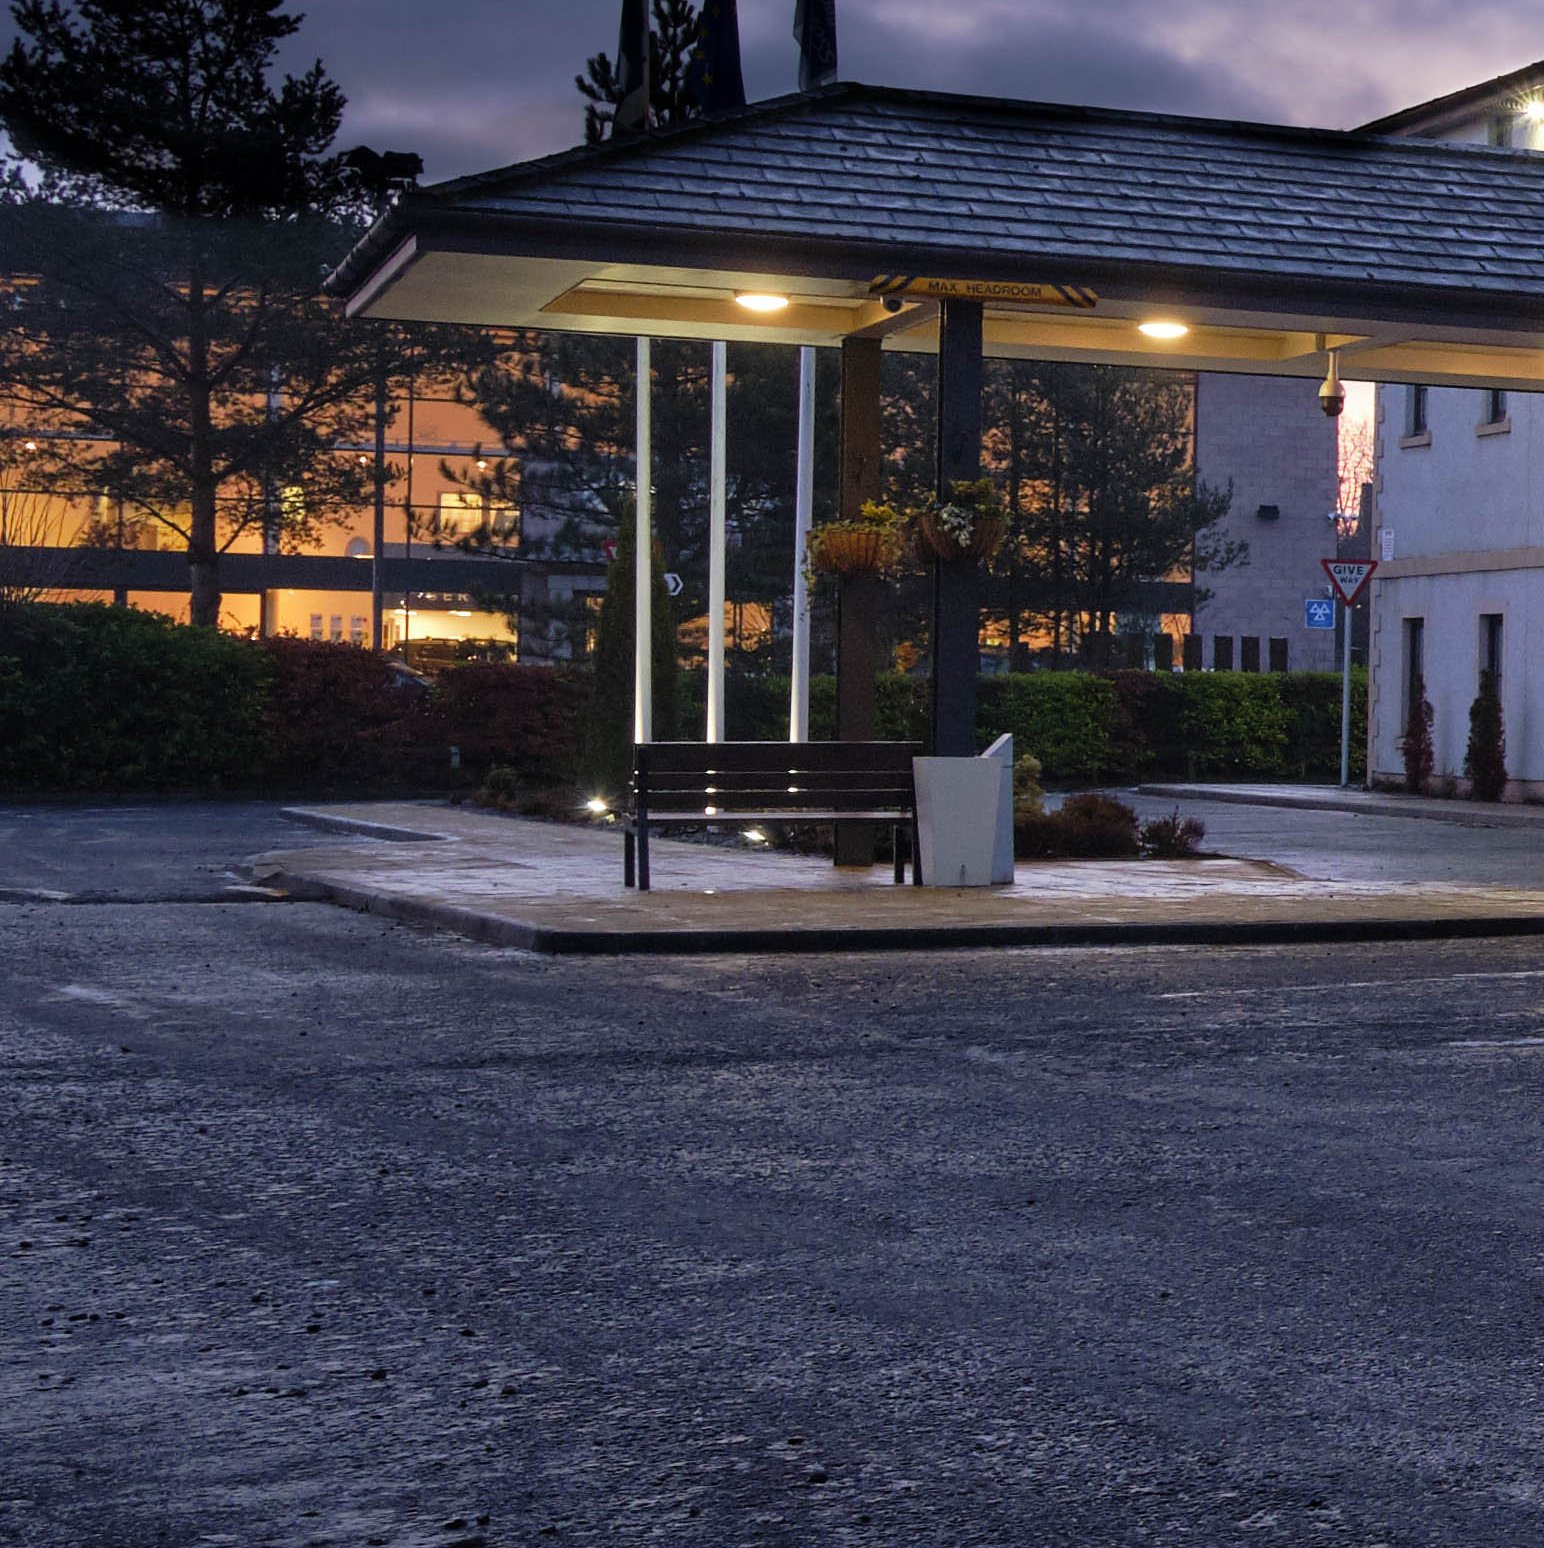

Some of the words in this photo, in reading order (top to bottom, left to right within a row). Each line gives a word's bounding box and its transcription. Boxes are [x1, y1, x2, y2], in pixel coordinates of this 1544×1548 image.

[966, 283, 1042, 297] HEADROOM
[1333, 565, 1364, 575] GIVE
[1340, 576, 1359, 584] WAY
